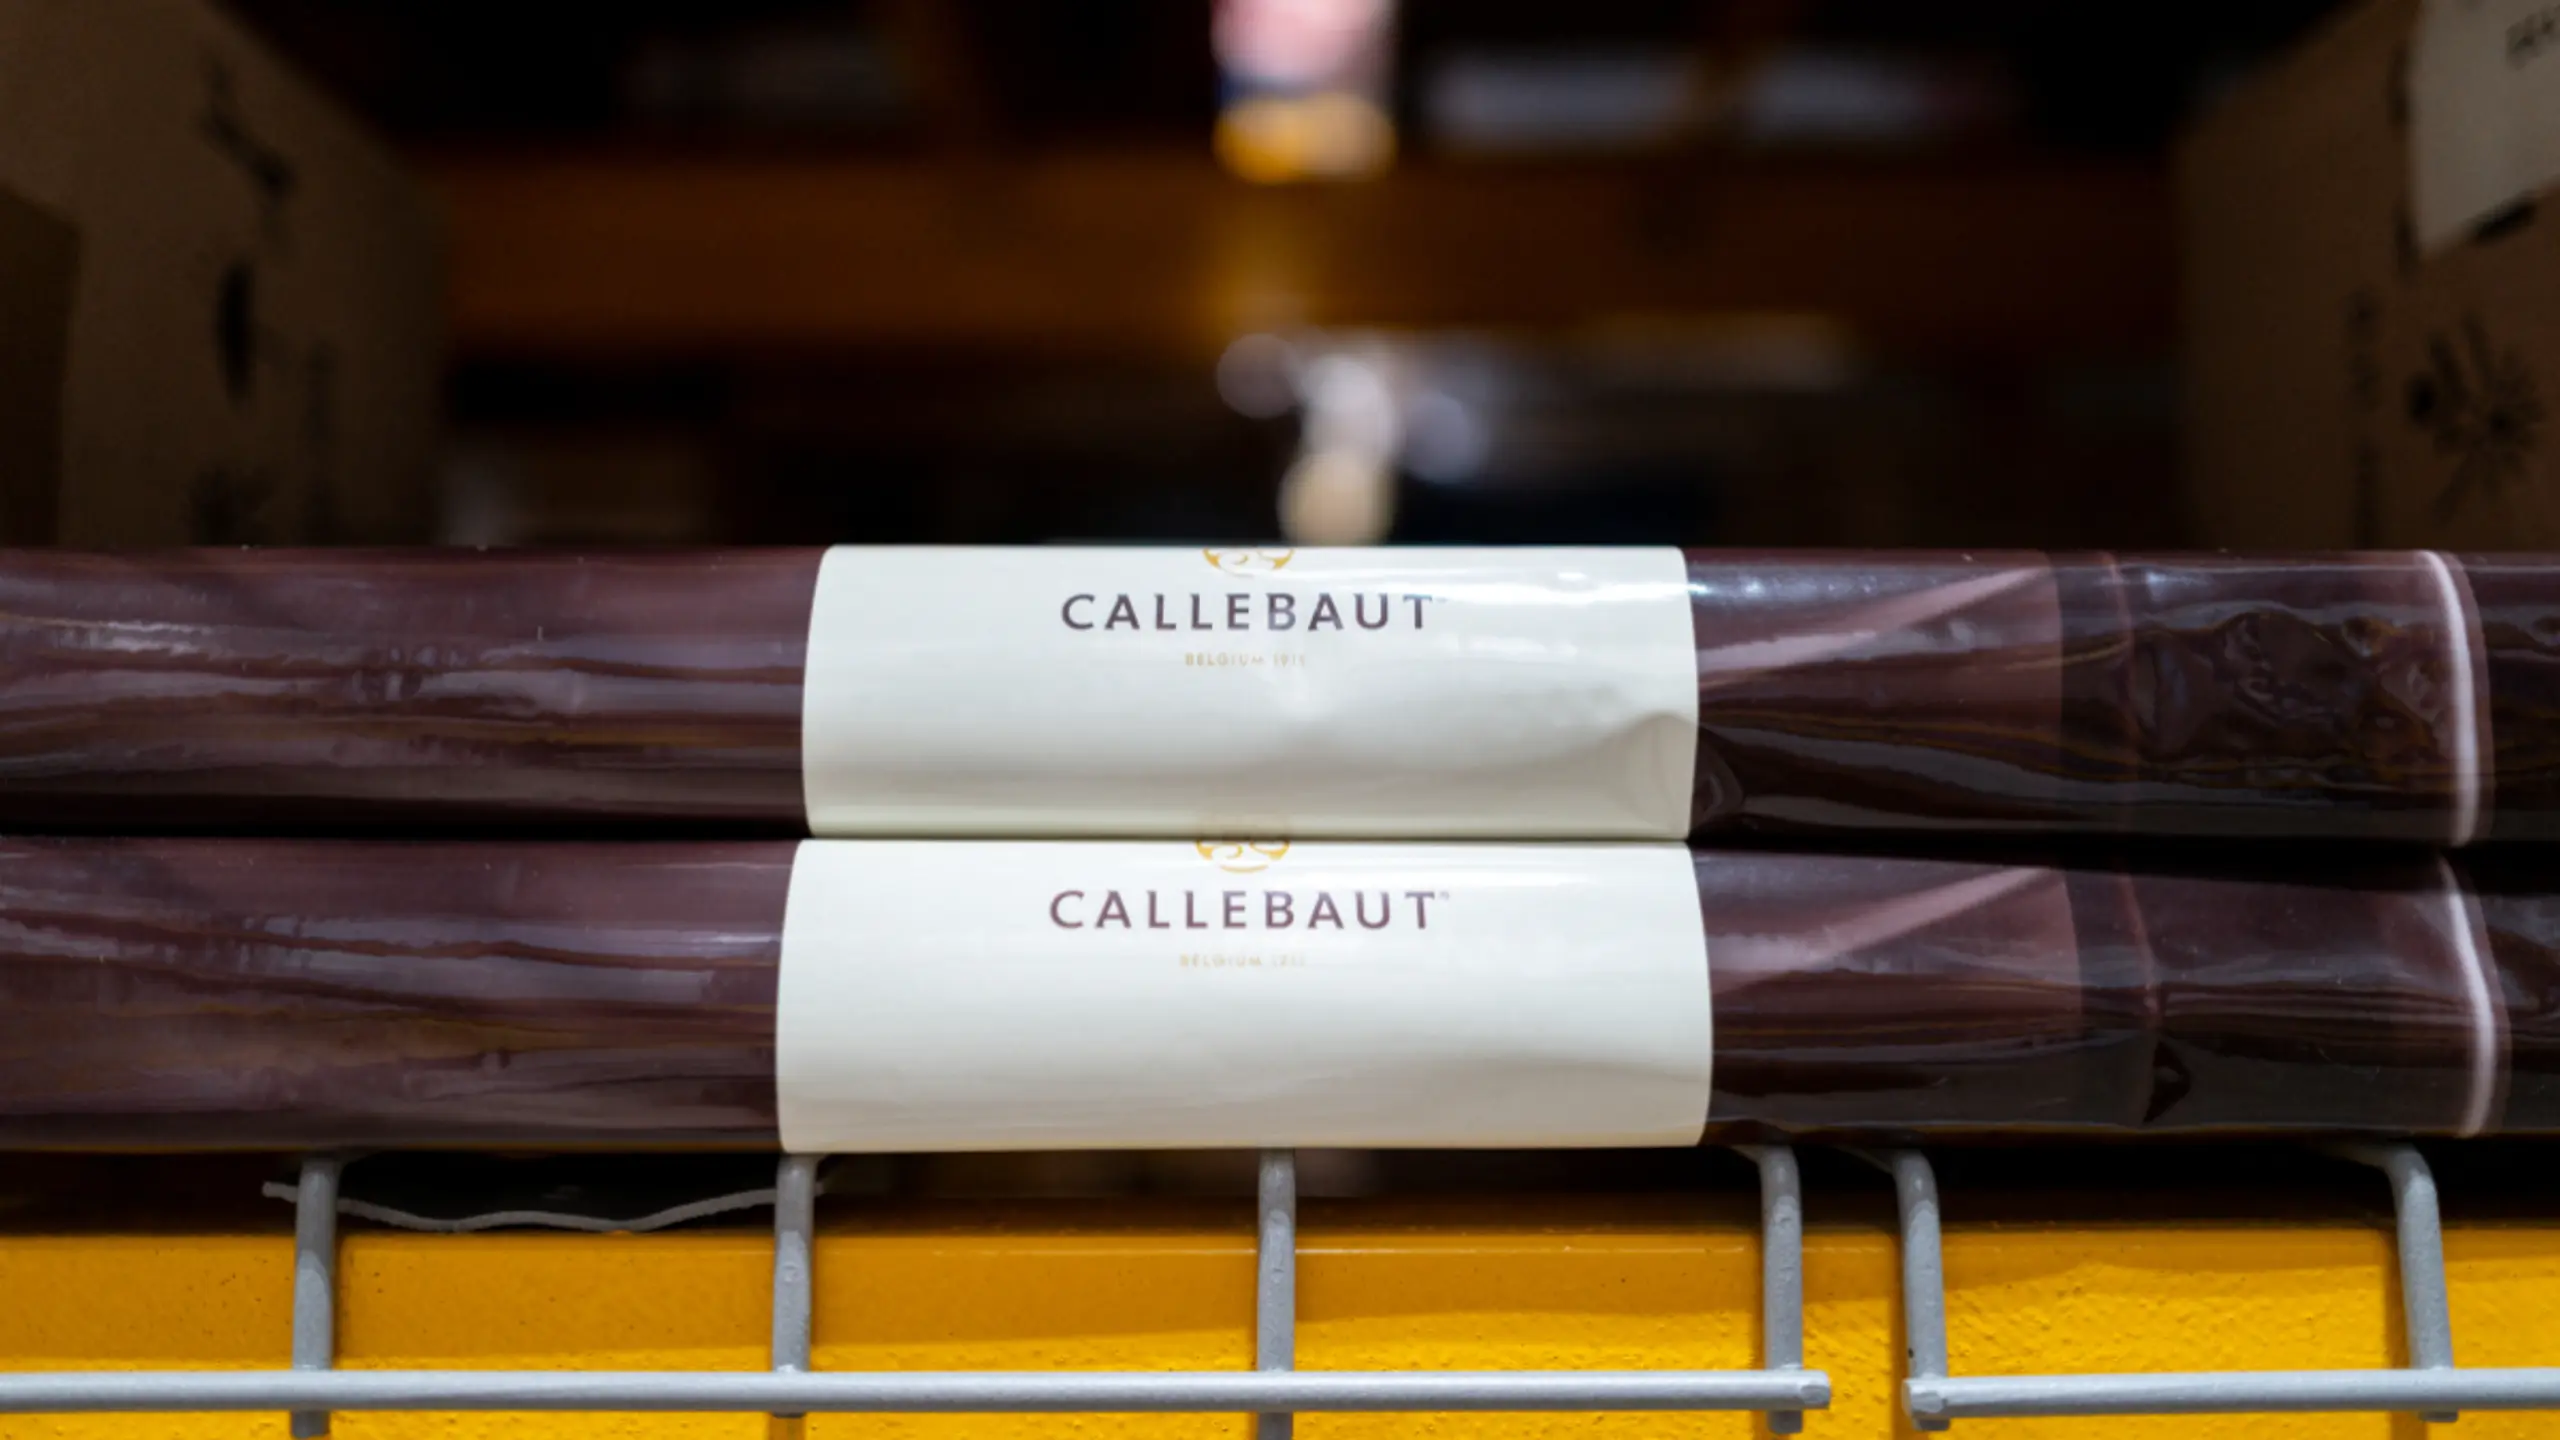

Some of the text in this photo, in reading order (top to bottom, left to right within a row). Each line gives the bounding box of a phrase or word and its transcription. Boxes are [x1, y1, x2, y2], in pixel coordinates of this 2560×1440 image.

[1060, 592, 1433, 632] CALLEBAUT
[1184, 652, 1265, 667] BELGIUM
[1048, 889, 1436, 931] CALLEBAUT
[1179, 952, 1263, 968] BELGIUM
